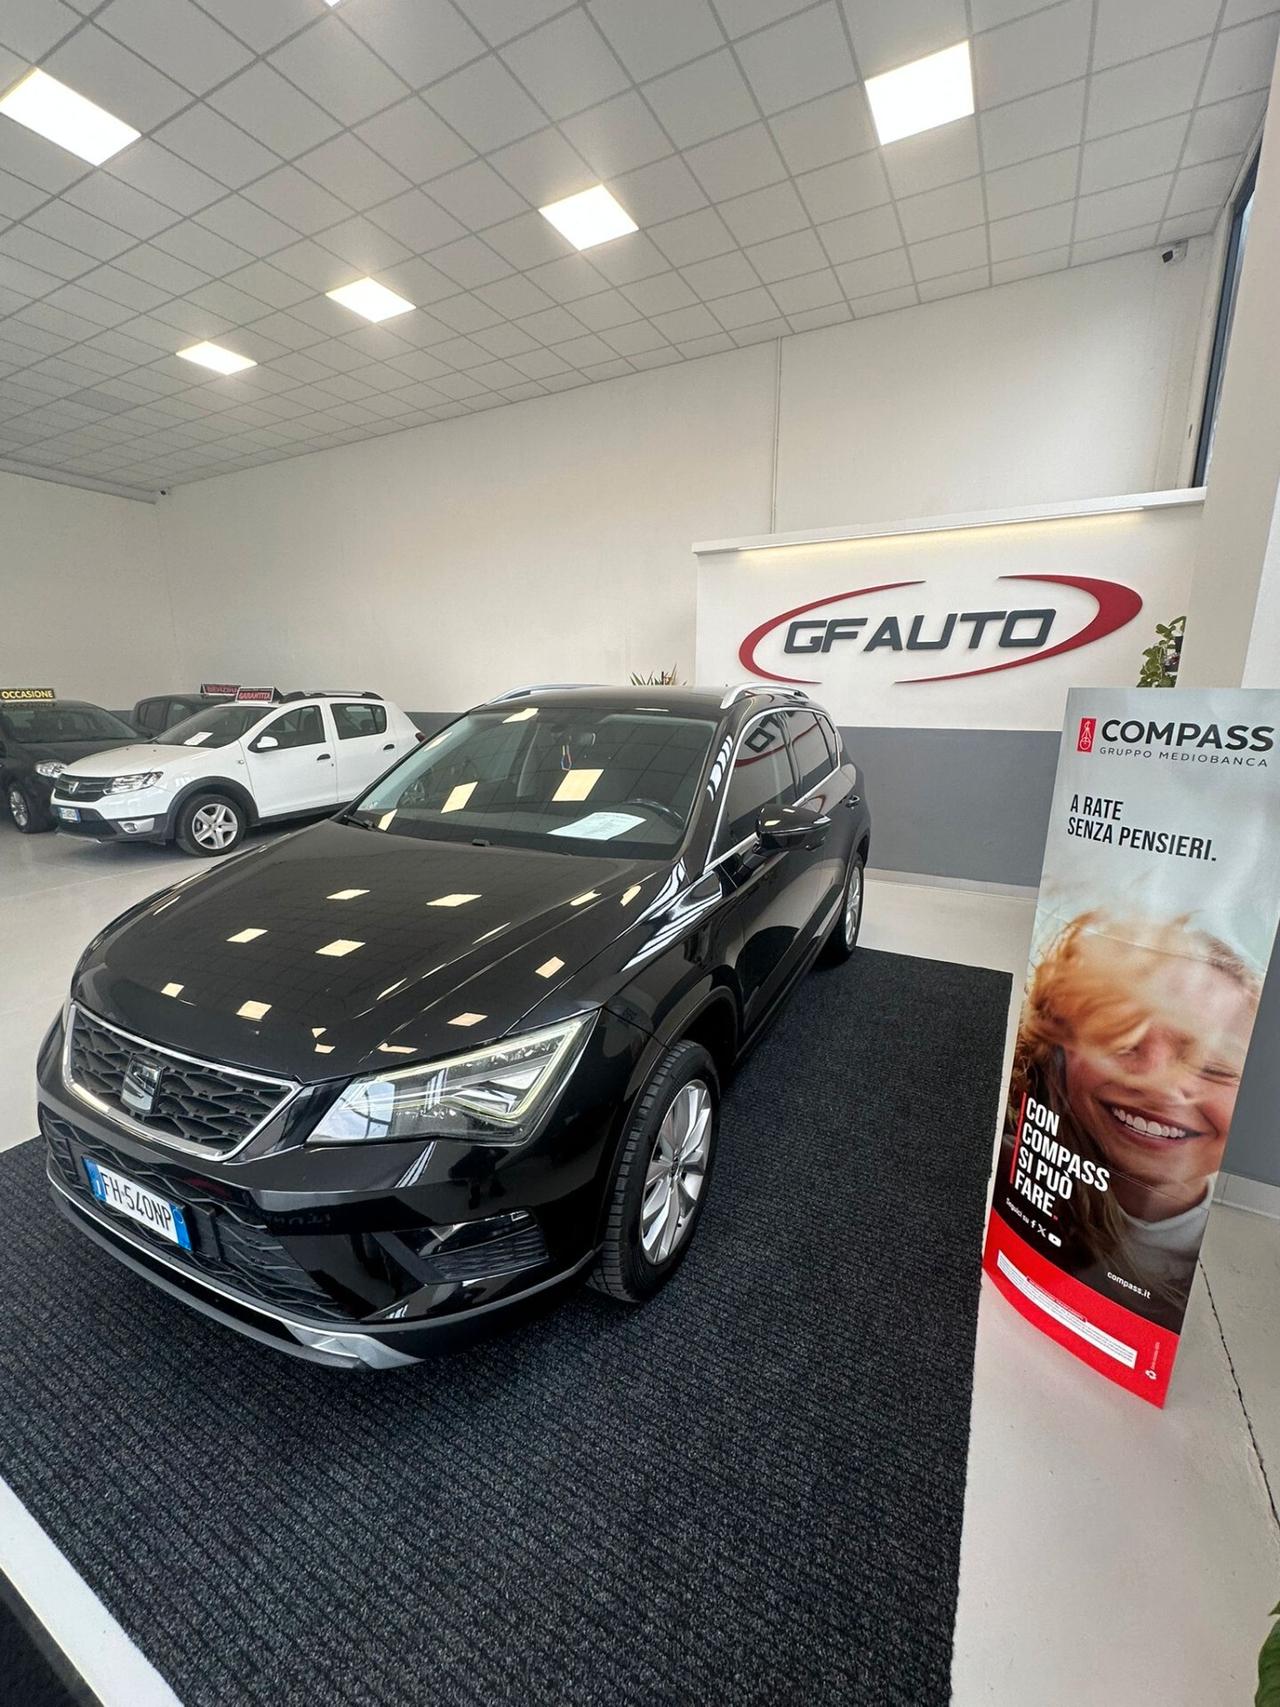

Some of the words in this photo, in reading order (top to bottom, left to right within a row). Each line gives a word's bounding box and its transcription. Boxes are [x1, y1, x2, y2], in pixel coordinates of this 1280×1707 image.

[1, 690, 54, 699] OCCASIONE
[1101, 719, 1275, 752] COMPASS
[1100, 746, 1152, 759] GRUPPO
[1158, 751, 1268, 768] MEDIOBANCA
[1070, 793, 1079, 813] A
[1082, 796, 1124, 821] RATE
[1067, 816, 1113, 844] SENZA
[1118, 826, 1217, 862] PENSIERI.
[1025, 1097, 1060, 1137] CON
[1018, 1145, 1034, 1174] SI
[1035, 1159, 1073, 1200] PUÒ
[1021, 1121, 1110, 1192] COMPASS
[1106, 1271, 1152, 1300] compass.it
